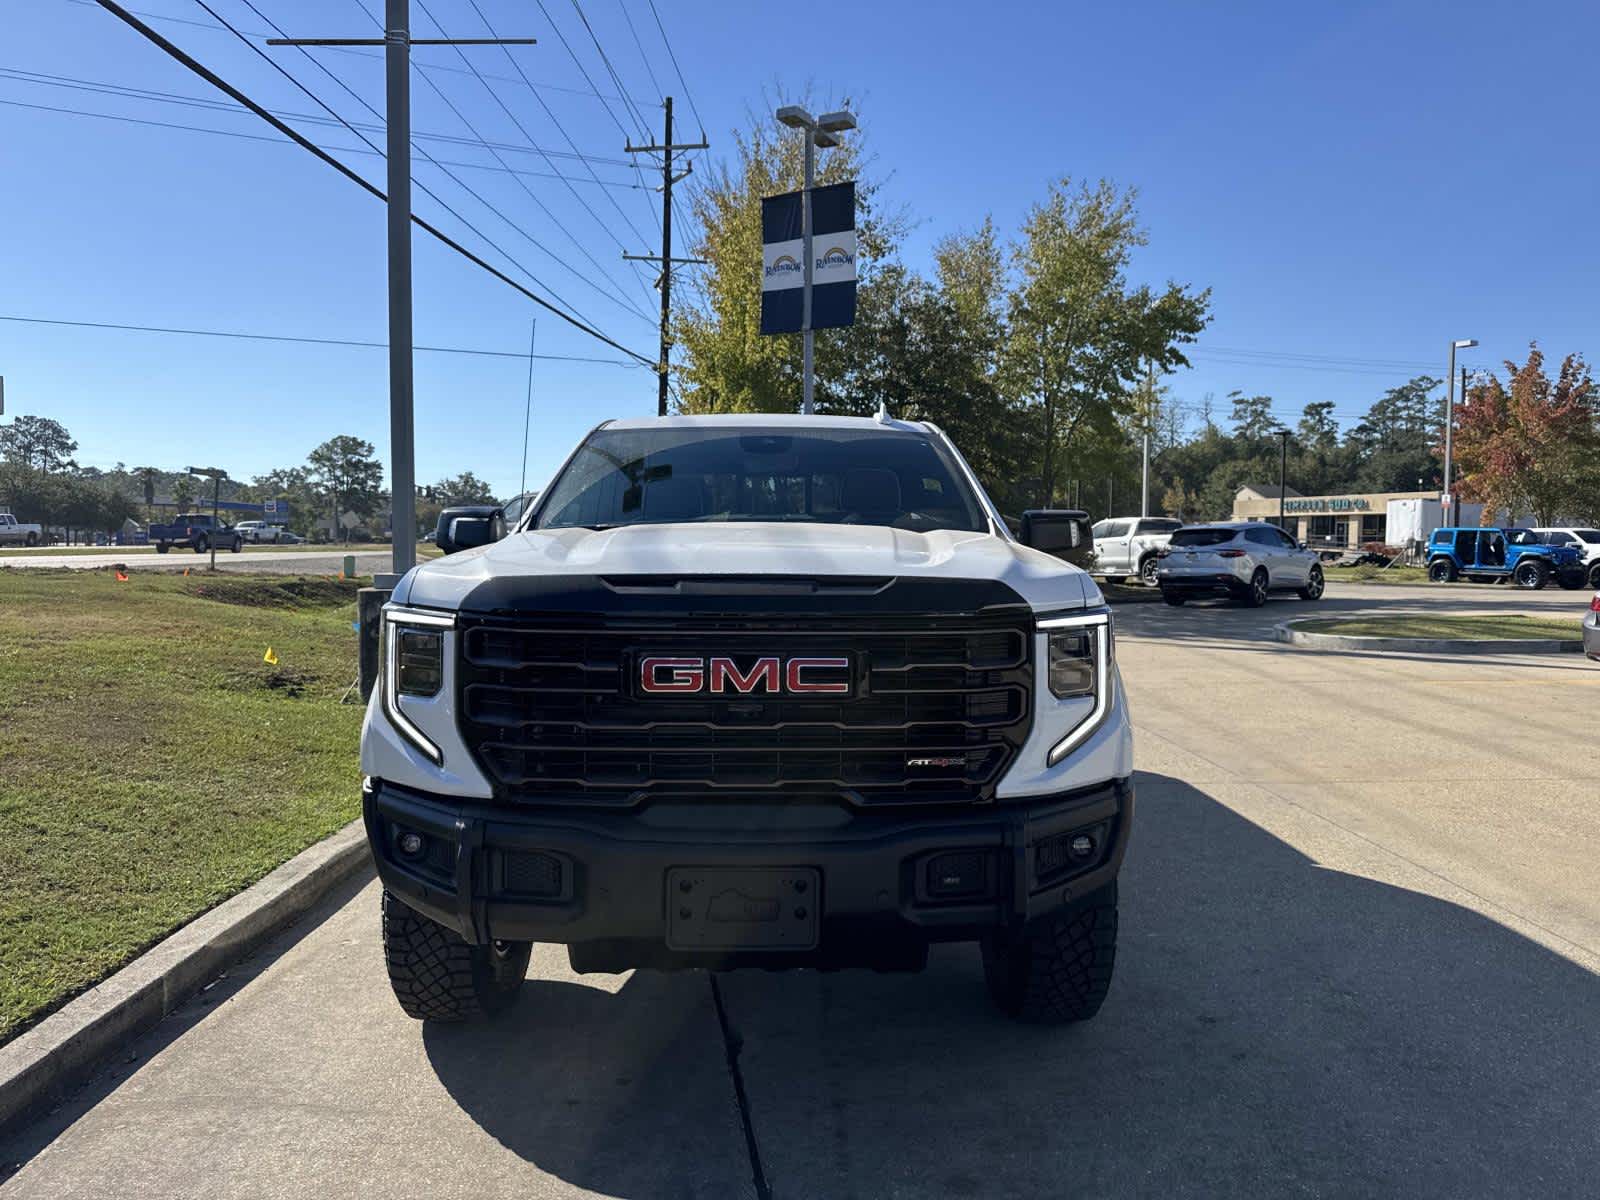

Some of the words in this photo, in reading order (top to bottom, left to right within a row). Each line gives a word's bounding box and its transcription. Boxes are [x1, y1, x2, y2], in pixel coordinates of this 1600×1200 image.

[816, 254, 854, 269] RAINBOW
[766, 262, 802, 277] RAINBOW
[641, 657, 849, 692] GMC
